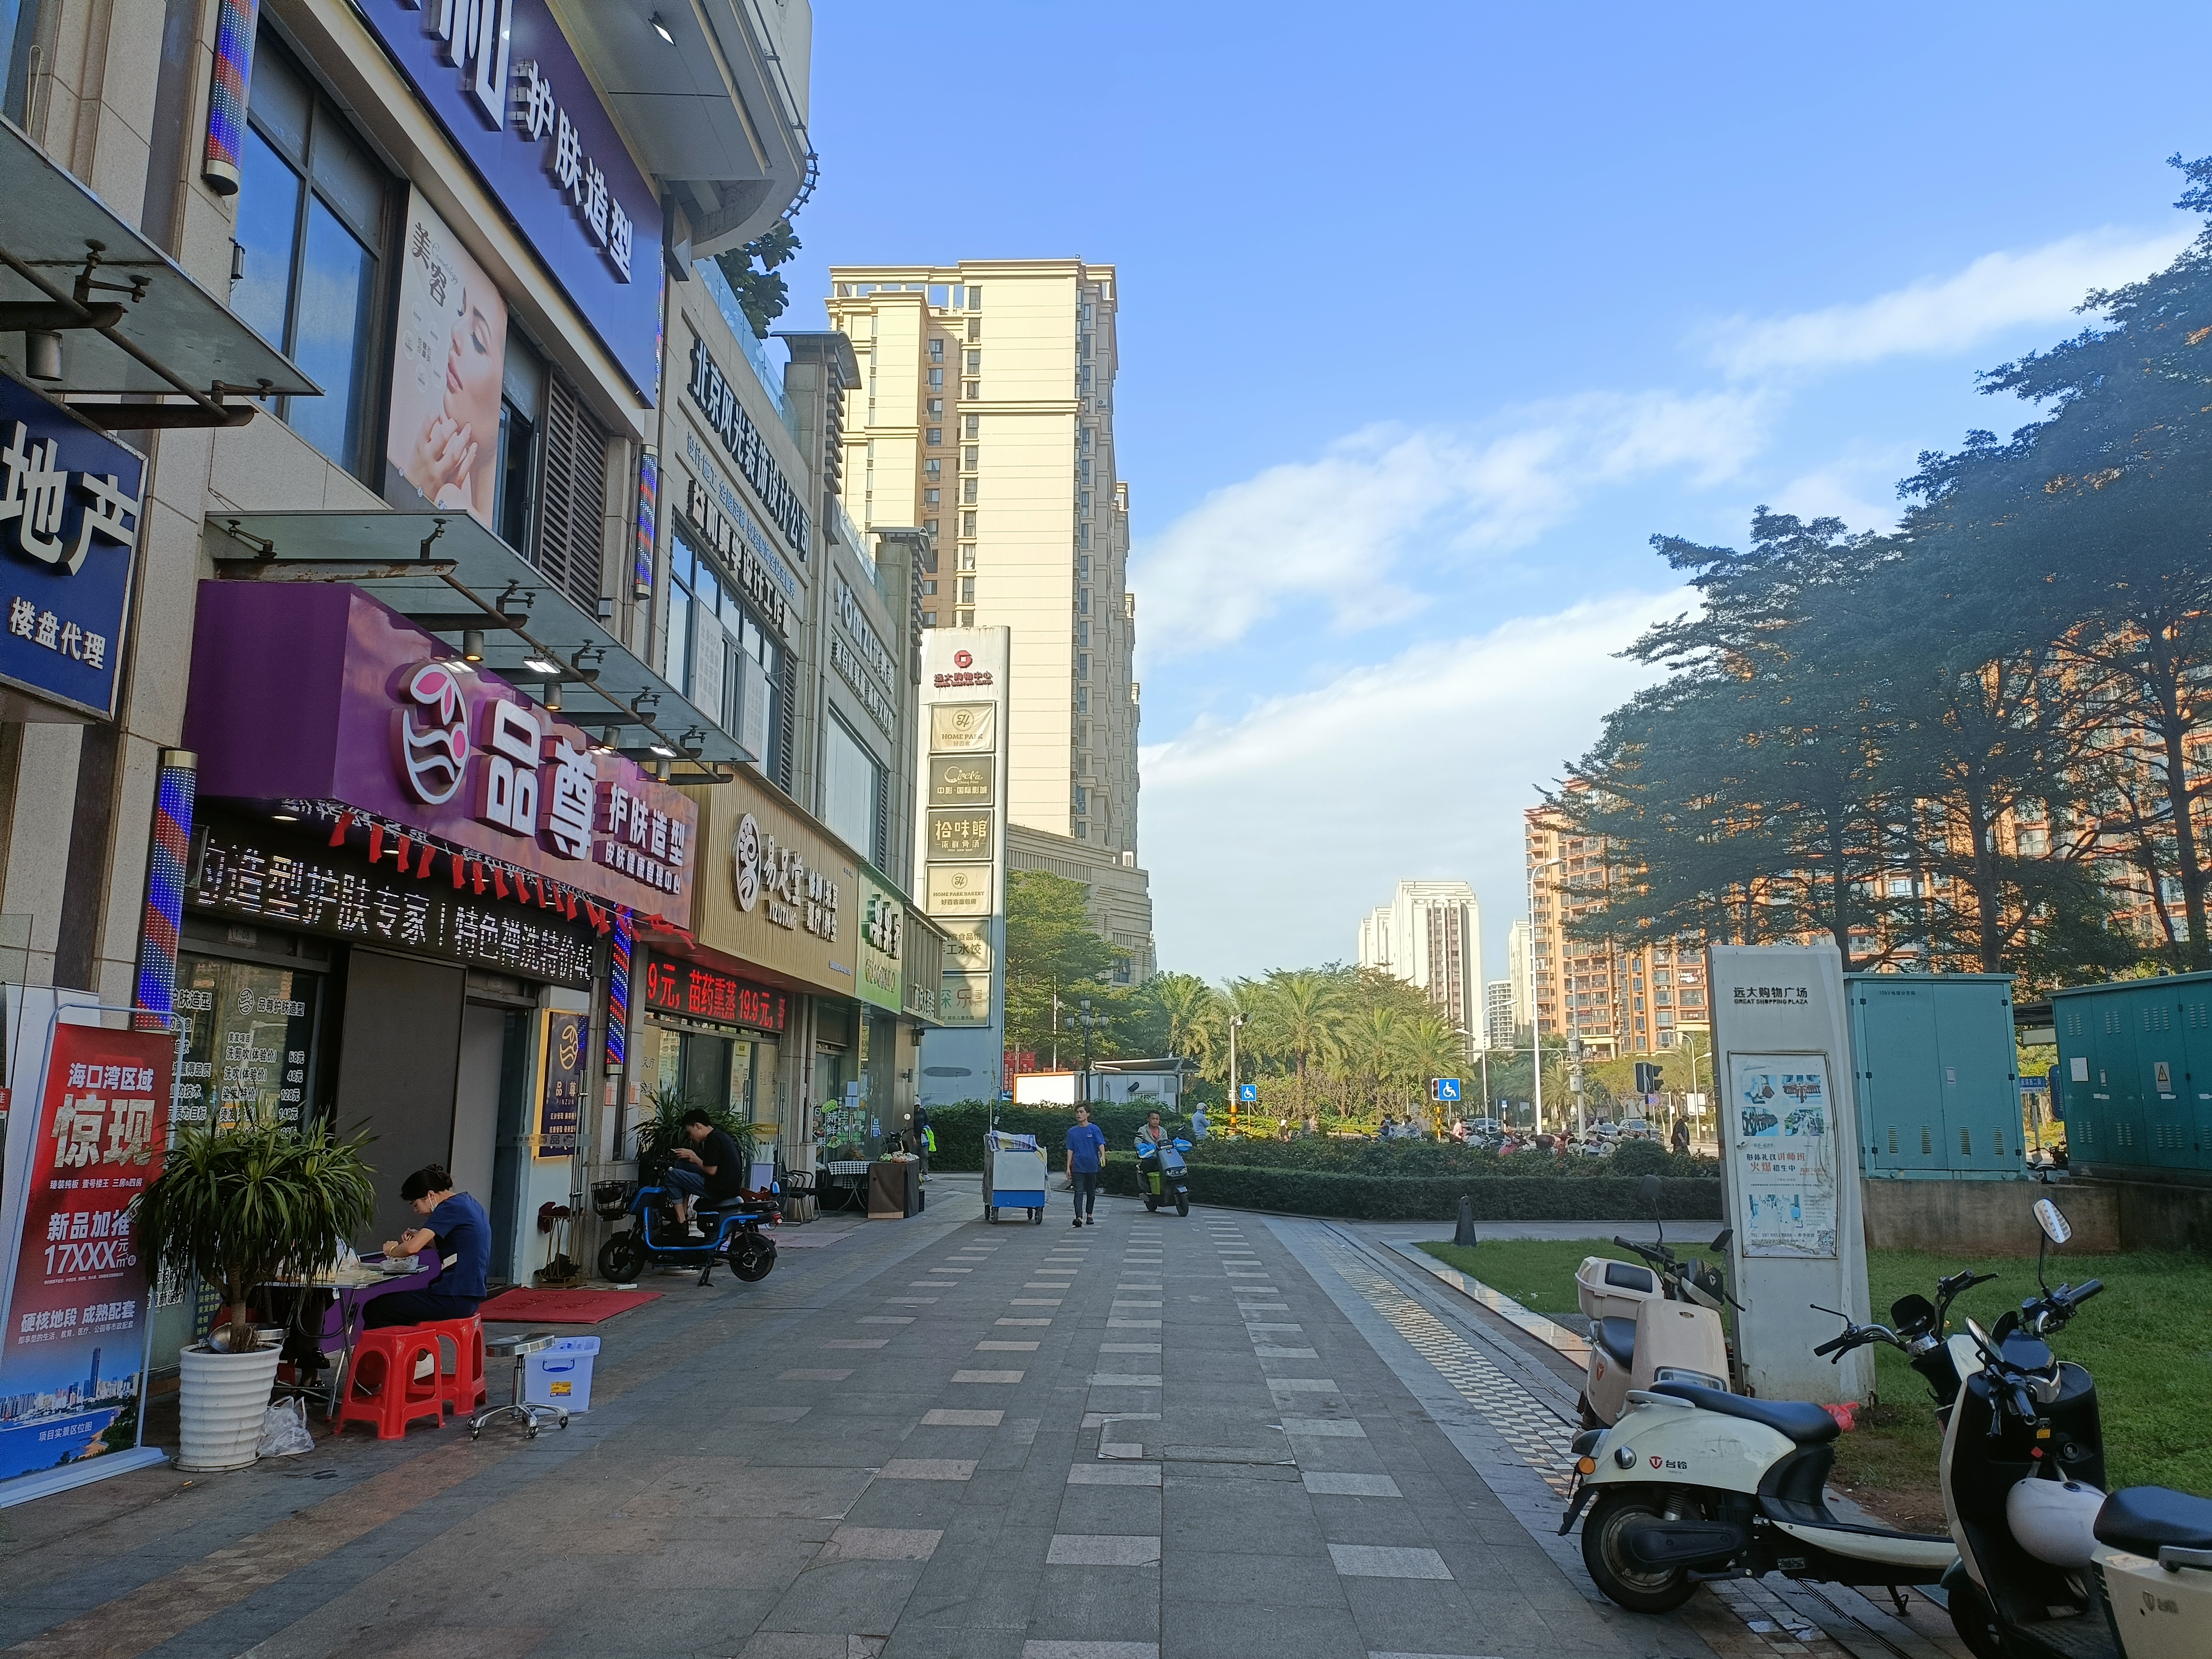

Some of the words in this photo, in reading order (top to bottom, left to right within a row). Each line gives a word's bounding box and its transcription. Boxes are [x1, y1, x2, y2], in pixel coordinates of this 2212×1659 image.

[527, 58, 633, 284] 护肤造型
[412, 221, 447, 308] 美容
[694, 339, 810, 562] 北京风光装饰设计公司
[0, 420, 138, 577] 地产
[693, 480, 791, 639] 益和美学设计工作室
[10, 596, 106, 670] 楼盘代理
[934, 670, 994, 682] 远大购物中心
[485, 697, 597, 861] 品尊
[609, 782, 685, 867] 护肤造型
[941, 840, 980, 849] 浓鲜骨汤
[605, 840, 681, 895] 皮肤健康管理中心
[768, 899, 797, 931] YIZUTANG
[943, 943, 982, 955] 工水饺
[947, 932, 982, 941] 客食品馆
[257, 997, 305, 1017] 品尊护肤造型
[1734, 986, 1808, 998] 远大购物广场
[67, 1062, 154, 1092] 海口湾区域
[287, 1070, 304, 1084] 48元
[280, 1088, 301, 1102] 128元
[51, 1094, 155, 1168] 惊现
[1747, 1152, 1805, 1161] 形体礼仪讲师班
[1750, 1162, 1795, 1172] 火爆招生中
[82, 1178, 109, 1189] 壹号楼王
[112, 1177, 143, 1188] 三房&四房
[46, 1211, 130, 1242] 新品加推
[44, 1240, 118, 1275] 17XXX
[21, 1306, 77, 1333] 硬核地段
[82, 1300, 136, 1325] 成熟配套
[38, 1422, 93, 1442] 项目实景区位图
[1665, 1460, 1688, 1470] 台铃
